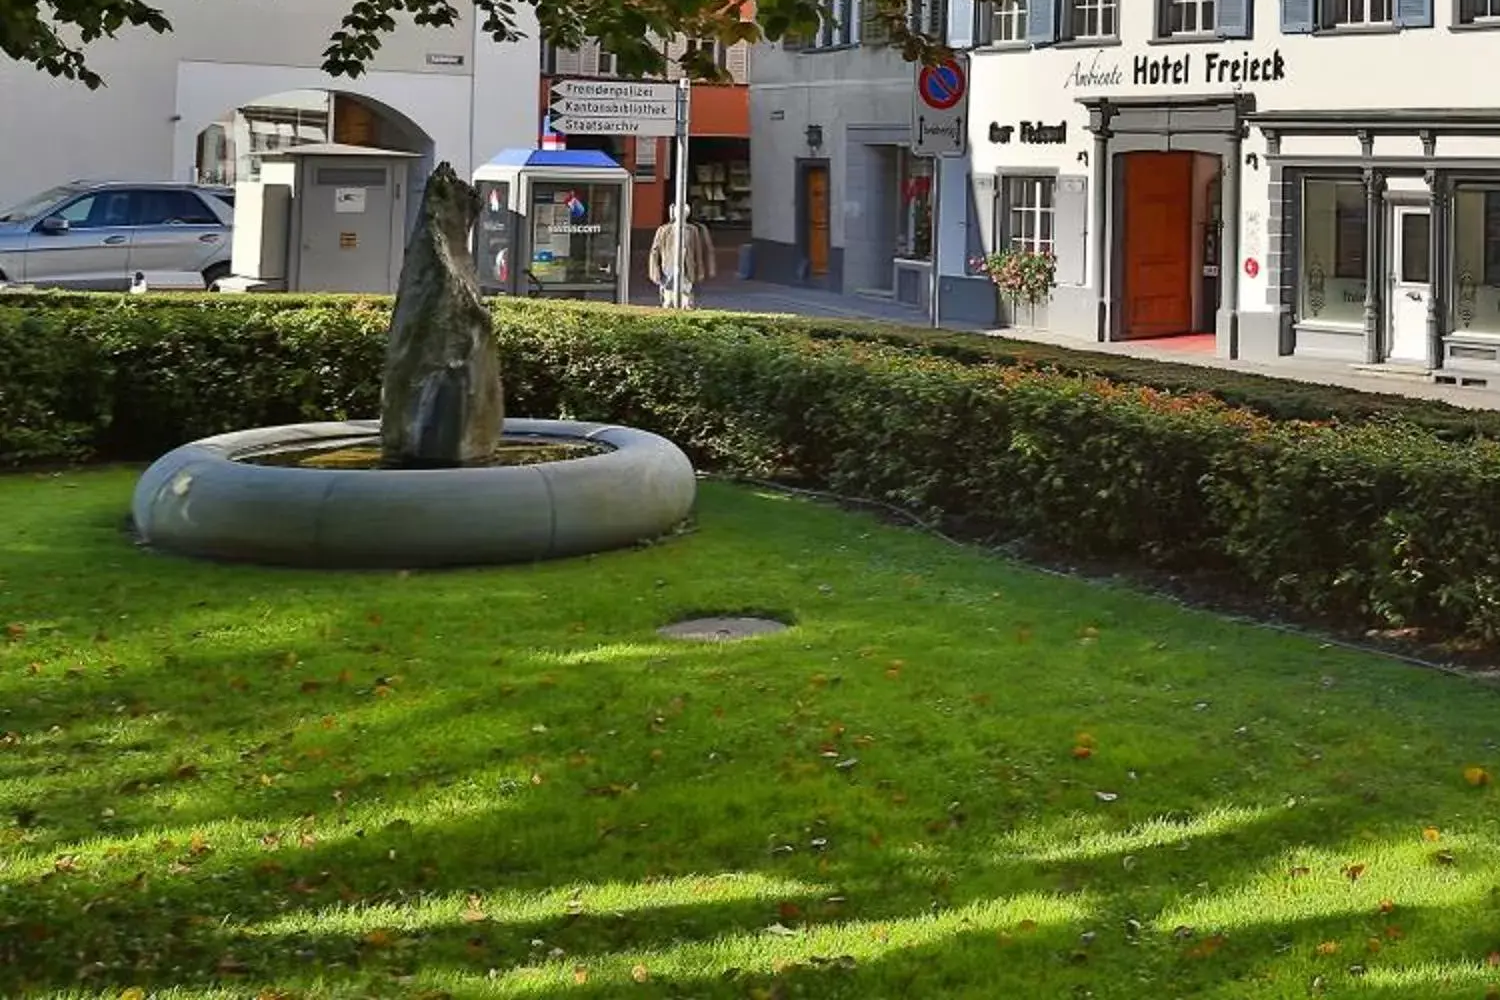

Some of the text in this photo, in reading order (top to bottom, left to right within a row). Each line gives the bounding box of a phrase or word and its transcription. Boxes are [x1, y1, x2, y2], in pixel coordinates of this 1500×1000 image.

[1064, 48, 1285, 88] Ambiente Hotel Freieck
[566, 83, 654, 98] Fremdenpolizei
[565, 101, 668, 115] Kantonsbibliothek
[565, 119, 641, 132] Staatsarchiv
